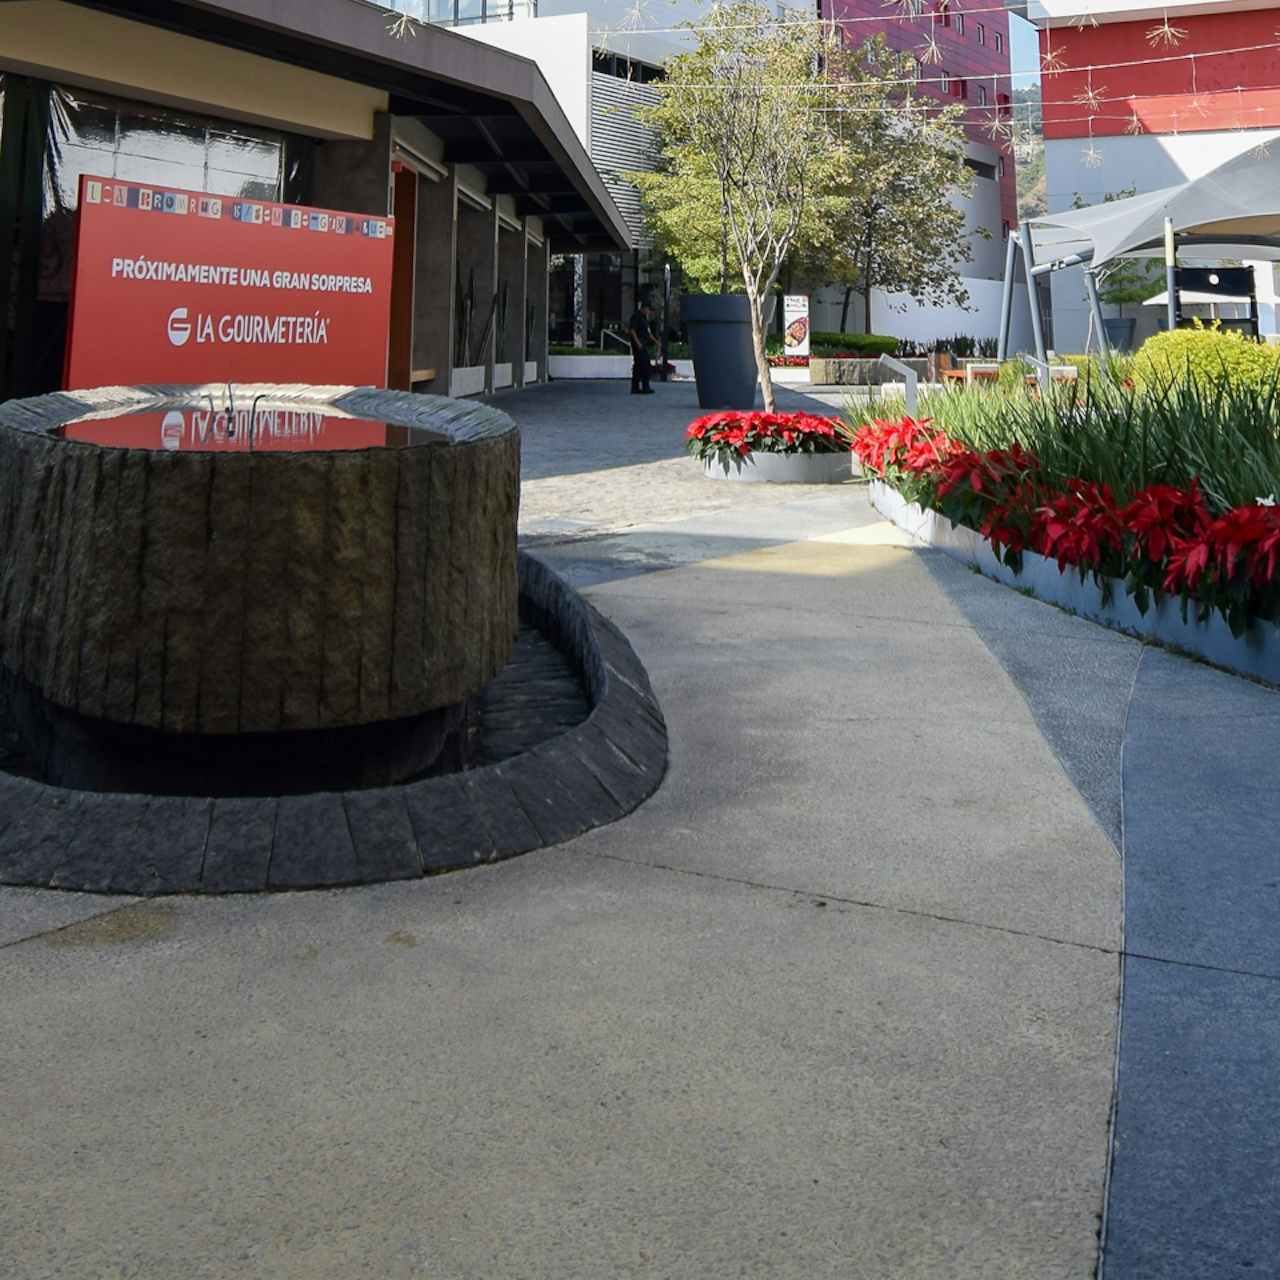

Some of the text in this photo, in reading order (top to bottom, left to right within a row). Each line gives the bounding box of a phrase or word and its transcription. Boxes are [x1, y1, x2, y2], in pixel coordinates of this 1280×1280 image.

[111, 256, 372, 293] PRÓXIMAMENTE UNA GRAN SORPRESA
[197, 314, 215, 343] LA
[218, 310, 328, 344] GOURMETERÍA
